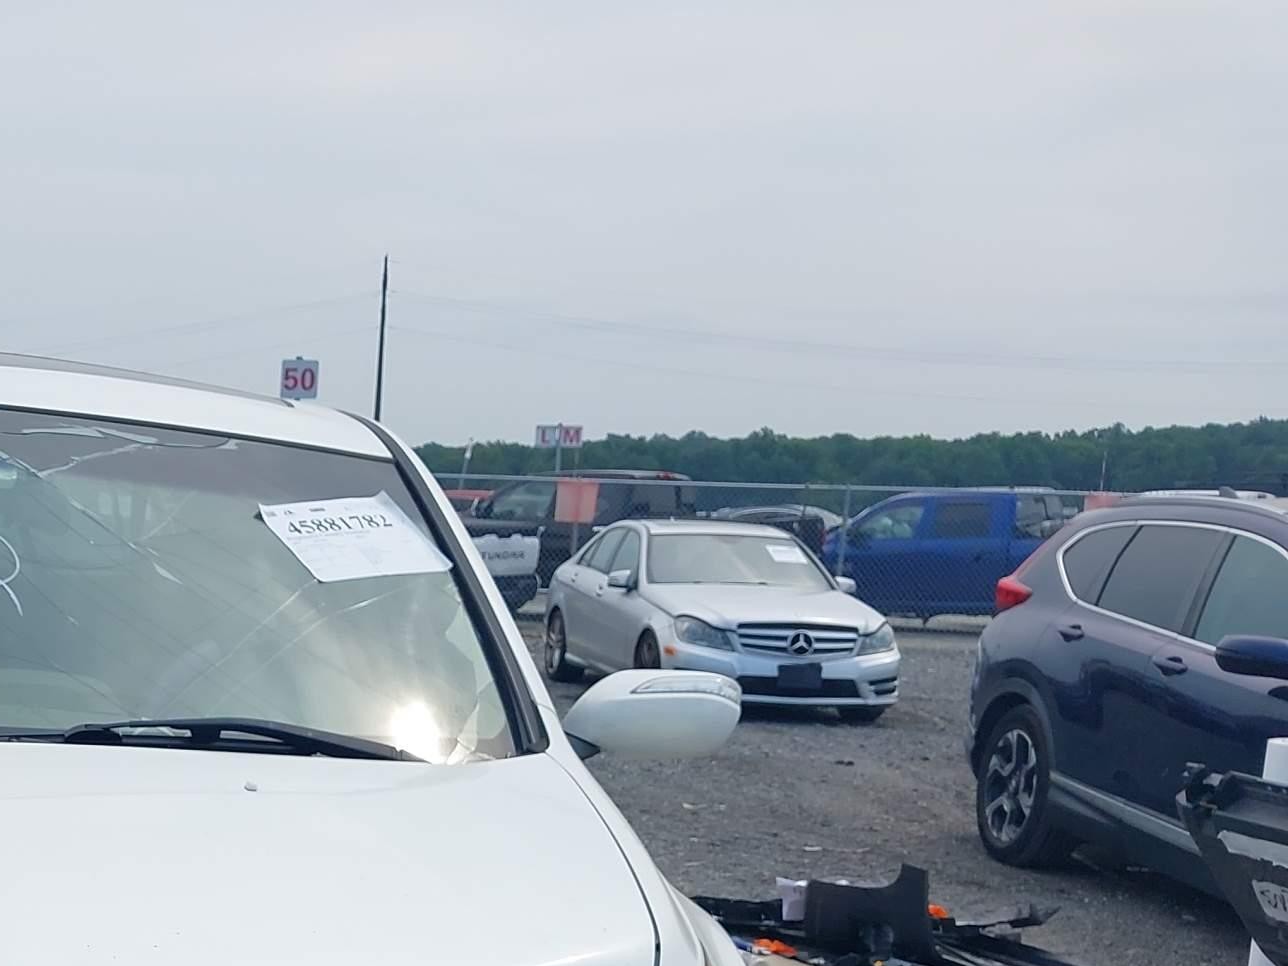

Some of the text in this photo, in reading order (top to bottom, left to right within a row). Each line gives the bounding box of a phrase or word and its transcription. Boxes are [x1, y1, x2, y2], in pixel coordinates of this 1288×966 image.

[284, 367, 315, 391] 50
[563, 429, 581, 444] M
[287, 514, 393, 535] 45881782
